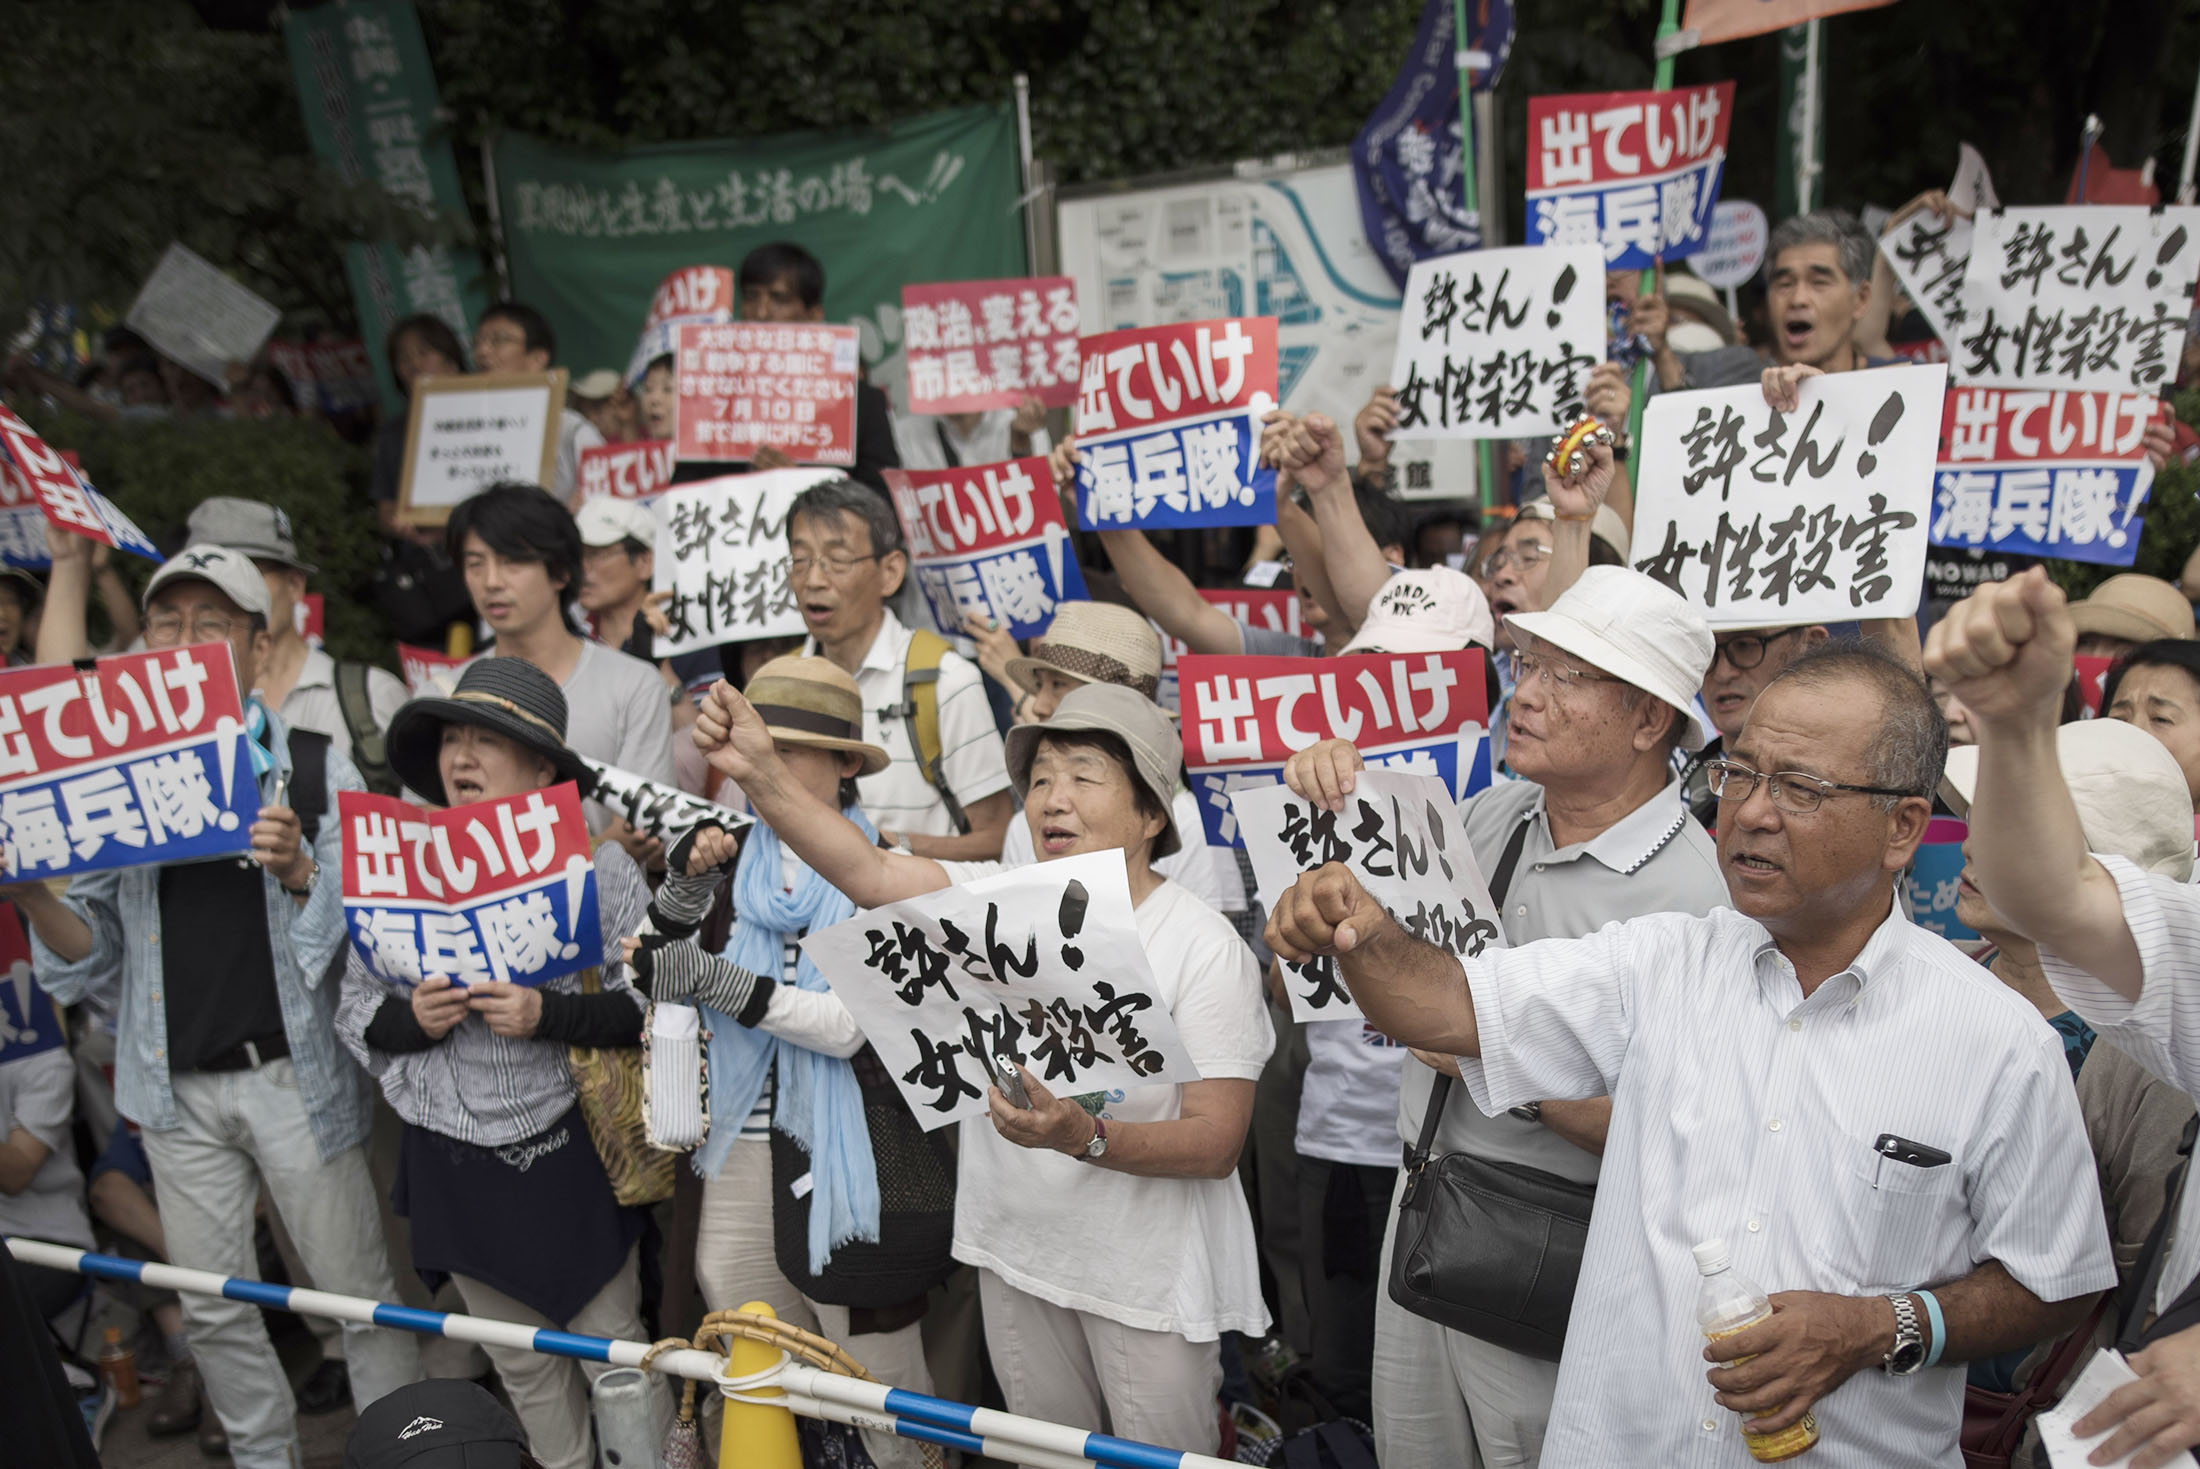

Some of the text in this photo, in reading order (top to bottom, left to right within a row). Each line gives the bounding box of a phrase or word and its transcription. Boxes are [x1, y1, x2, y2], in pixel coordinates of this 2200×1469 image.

[1541, 88, 1721, 187] 出ていけ
[1535, 145, 1723, 263] 海兵隊!
[1421, 263, 1579, 345] 許さん!
[2001, 221, 2188, 297] 許さん!
[1077, 321, 1254, 436] 出ていけ
[1393, 341, 1598, 428] 女性殺害
[1962, 302, 2190, 385] 女性殺害
[1079, 391, 1272, 527] 海兵隊!
[1680, 391, 1905, 501] 許さん!
[1951, 390, 2158, 461] 出ていけ
[896, 463, 1035, 555] 出ていけ
[1634, 492, 1918, 608] 女性殺害
[1933, 453, 2156, 548] 海兵隊!
[1195, 654, 1458, 764] 出ていけ
[0, 716, 239, 878] 海兵隊!
[354, 792, 560, 898] 出ていけ
[1278, 794, 1454, 882] 許さん!
[354, 854, 588, 985] 海兵隊!
[864, 878, 1090, 1006] 許さん!
[903, 980, 1166, 1113] 女性殺害
[494, 1127, 570, 1173] Egoist
